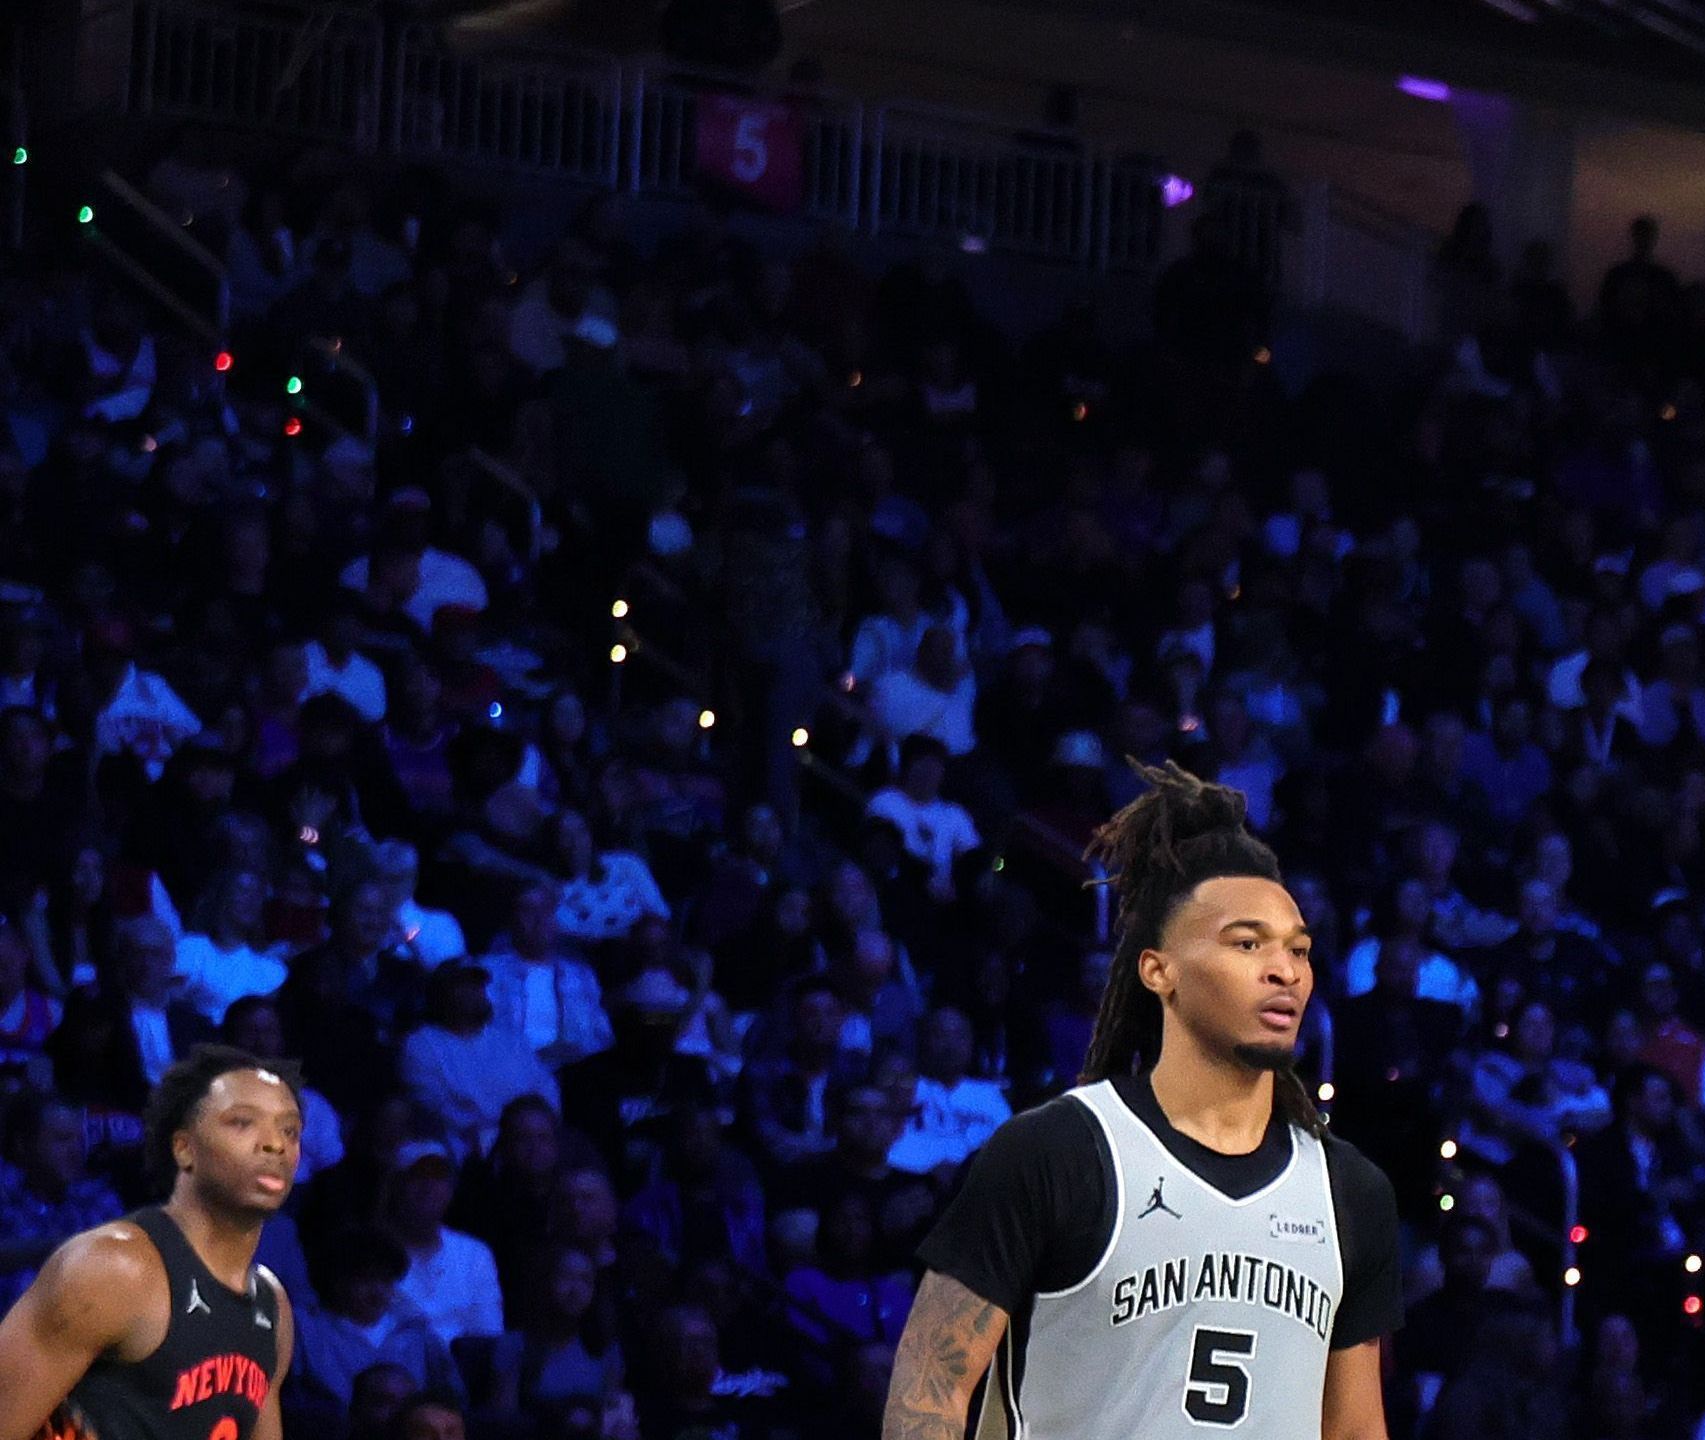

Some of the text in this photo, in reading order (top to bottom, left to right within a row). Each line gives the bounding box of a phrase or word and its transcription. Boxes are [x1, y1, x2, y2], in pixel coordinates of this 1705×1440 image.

[732, 112, 769, 183] 5
[1110, 1251, 1334, 1343] SAN ANTONIO
[171, 1355, 235, 1410] NEW
[1182, 1325, 1257, 1430] 5
